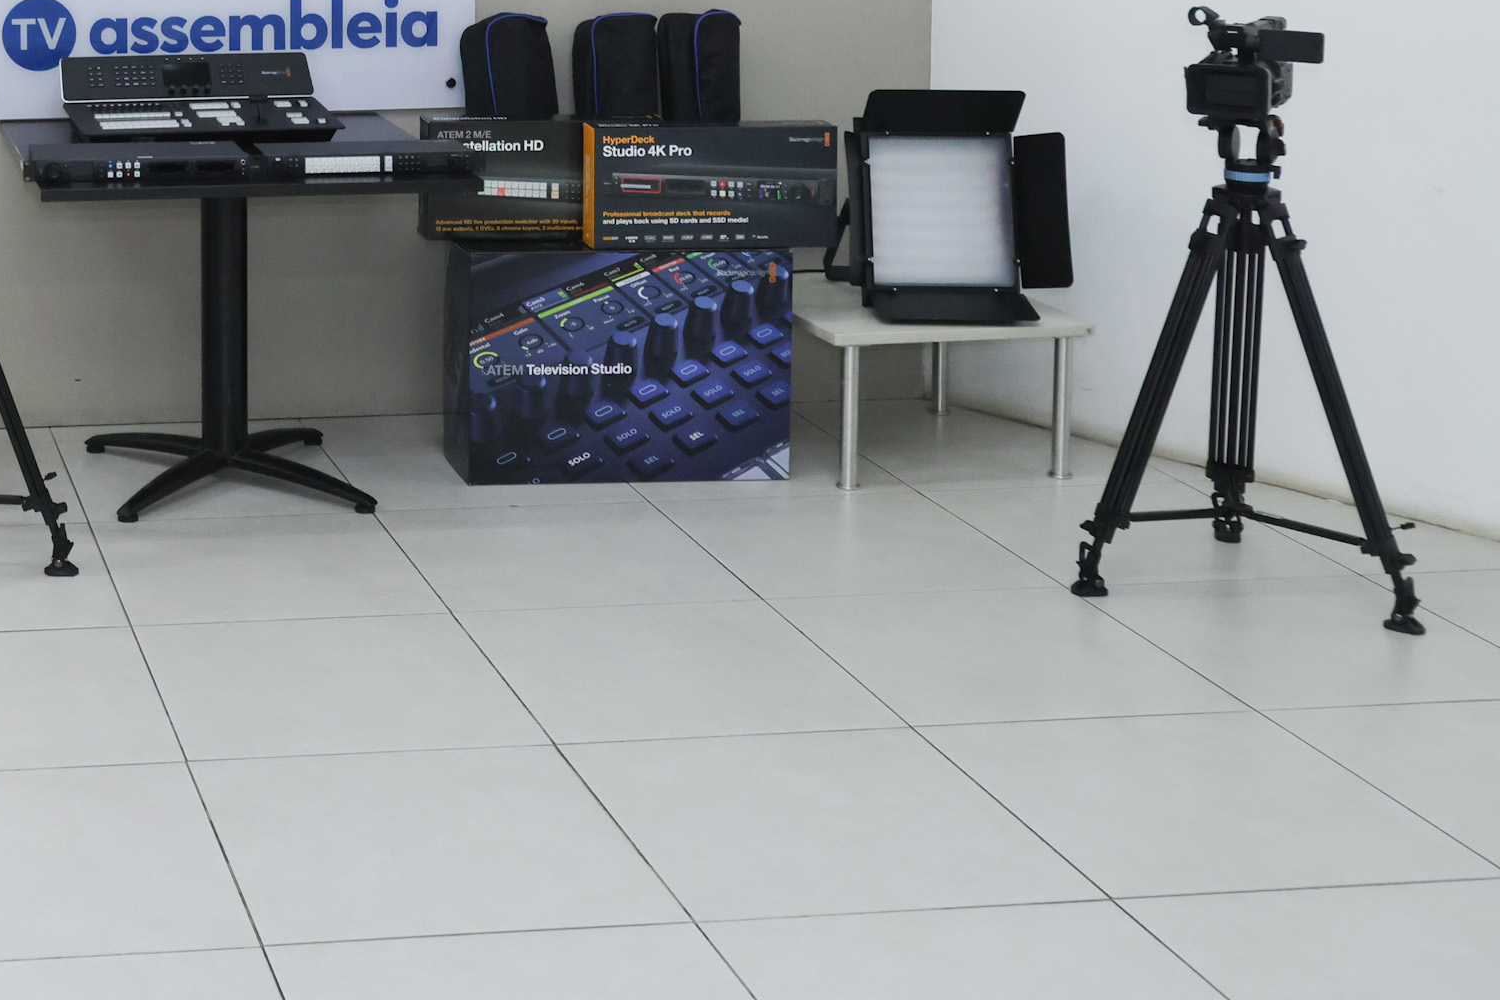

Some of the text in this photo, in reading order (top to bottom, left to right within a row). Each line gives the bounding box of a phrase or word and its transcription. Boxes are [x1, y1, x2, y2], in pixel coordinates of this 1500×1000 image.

[11, 17, 66, 50] TV
[437, 130, 492, 139] ATEM 2 M/E
[603, 135, 655, 145] HyperDeck
[463, 139, 544, 151] stellation HD
[602, 145, 692, 157] Studio 4K Pro
[554, 310, 572, 320] Zoom
[487, 363, 632, 375] ATEM Television Studio
[743, 365, 762, 377] SOLO
[703, 384, 723, 398] SOLO
[771, 388, 784, 397] SEL
[661, 405, 682, 419] SOLO
[731, 408, 746, 418] SEL
[616, 428, 638, 442] SOLO
[689, 431, 705, 441] SEL
[568, 452, 591, 466] SOLO
[644, 455, 659, 465] SEL
